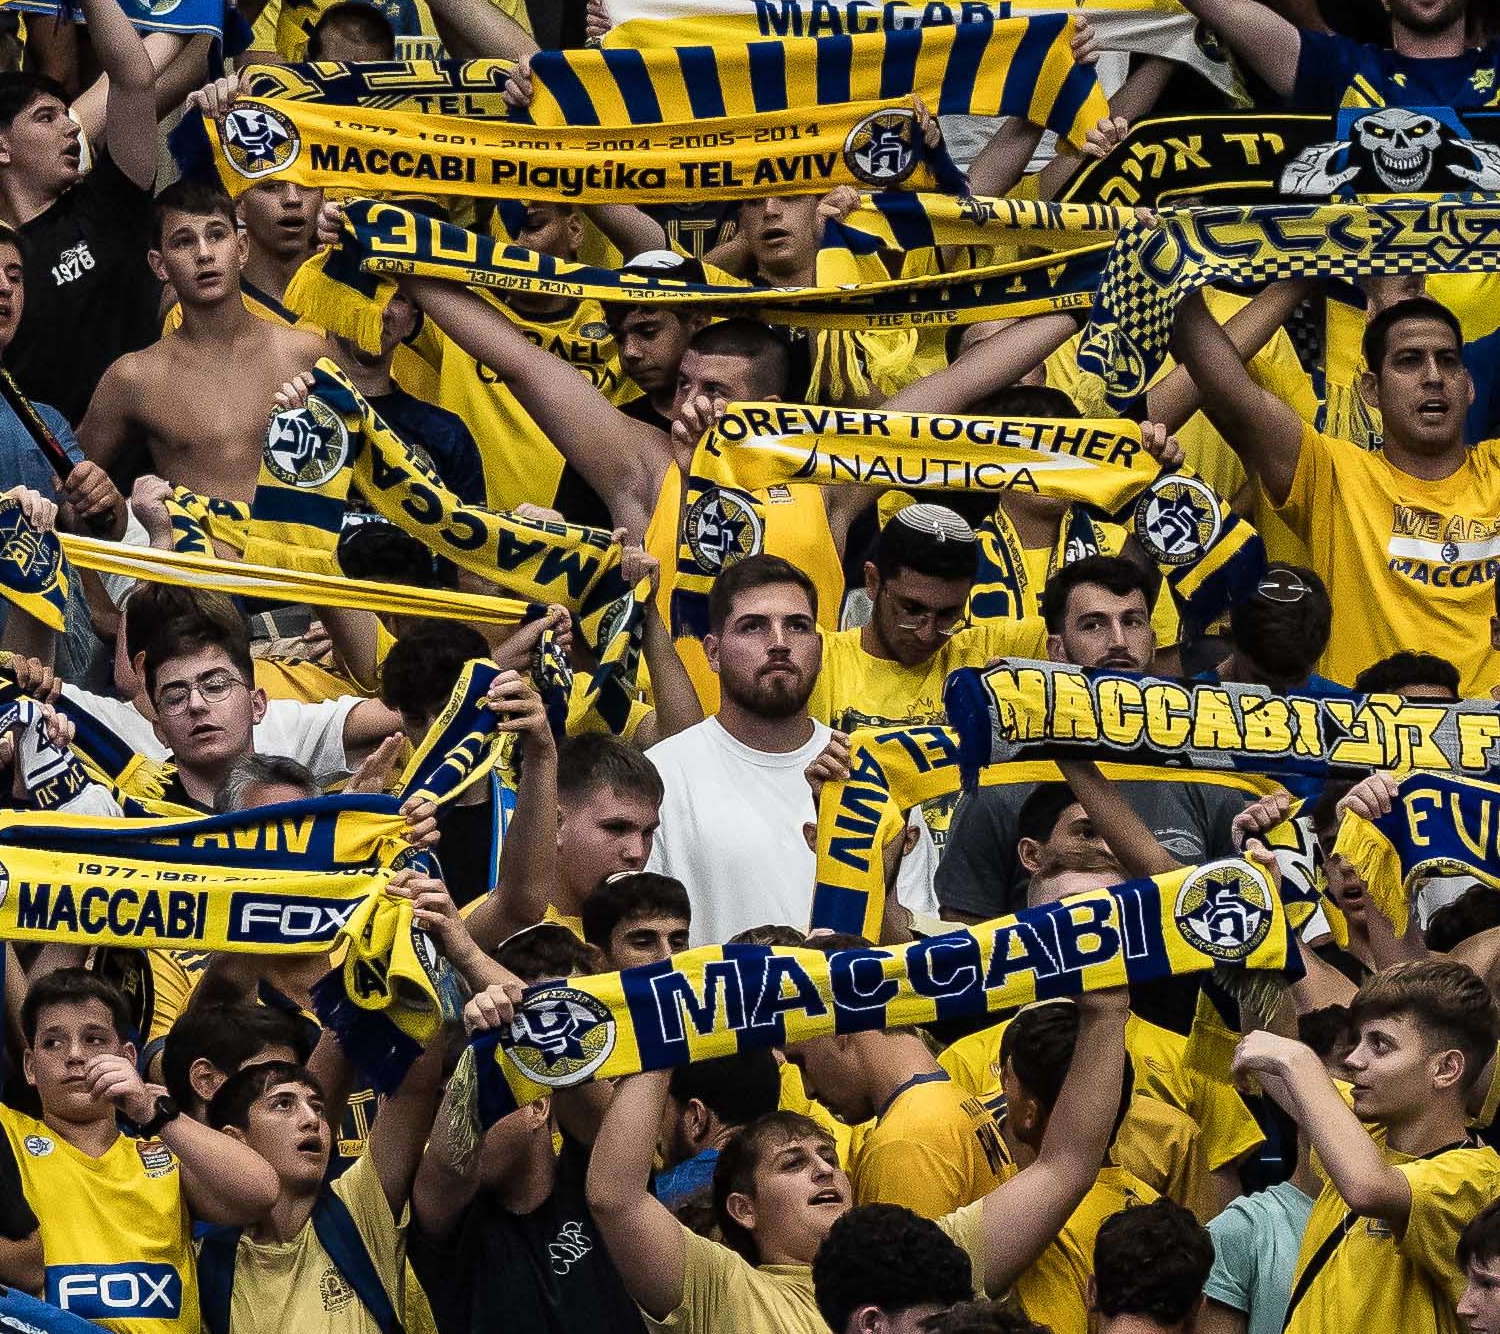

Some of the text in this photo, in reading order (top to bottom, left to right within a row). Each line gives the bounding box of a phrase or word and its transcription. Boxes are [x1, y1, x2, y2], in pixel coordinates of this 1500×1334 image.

[415, 95, 485, 115] TEL
[310, 141, 838, 197] MACCABI Playtika TEL AVIV
[1222, 130, 1284, 165] יד
[908, 416, 1141, 468] TOGETHER
[829, 453, 1040, 493] NAUTICA
[1393, 504, 1441, 535] WE
[982, 669, 1323, 757] MACCABI
[18, 883, 369, 942] MACCABI FOX
[648, 877, 1148, 1045] MACCABI
[57, 1273, 176, 1310] FOX
